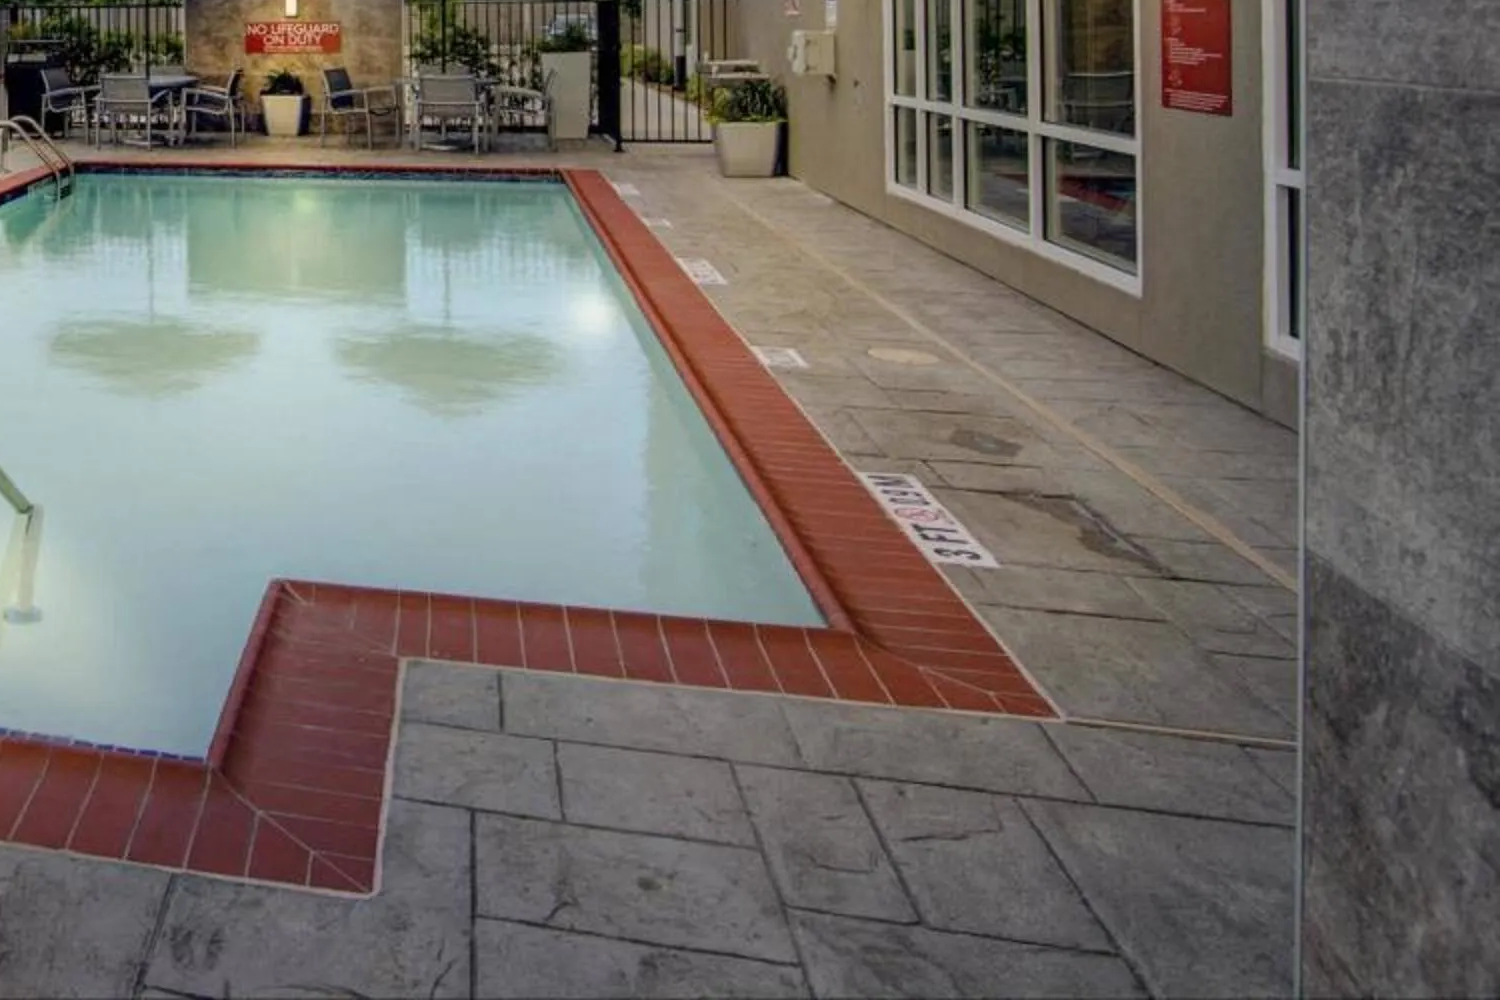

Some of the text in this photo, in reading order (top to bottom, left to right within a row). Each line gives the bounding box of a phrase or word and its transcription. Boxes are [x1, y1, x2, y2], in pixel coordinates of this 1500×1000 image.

[247, 24, 268, 35] NO
[263, 33, 321, 45] ON DUTY
